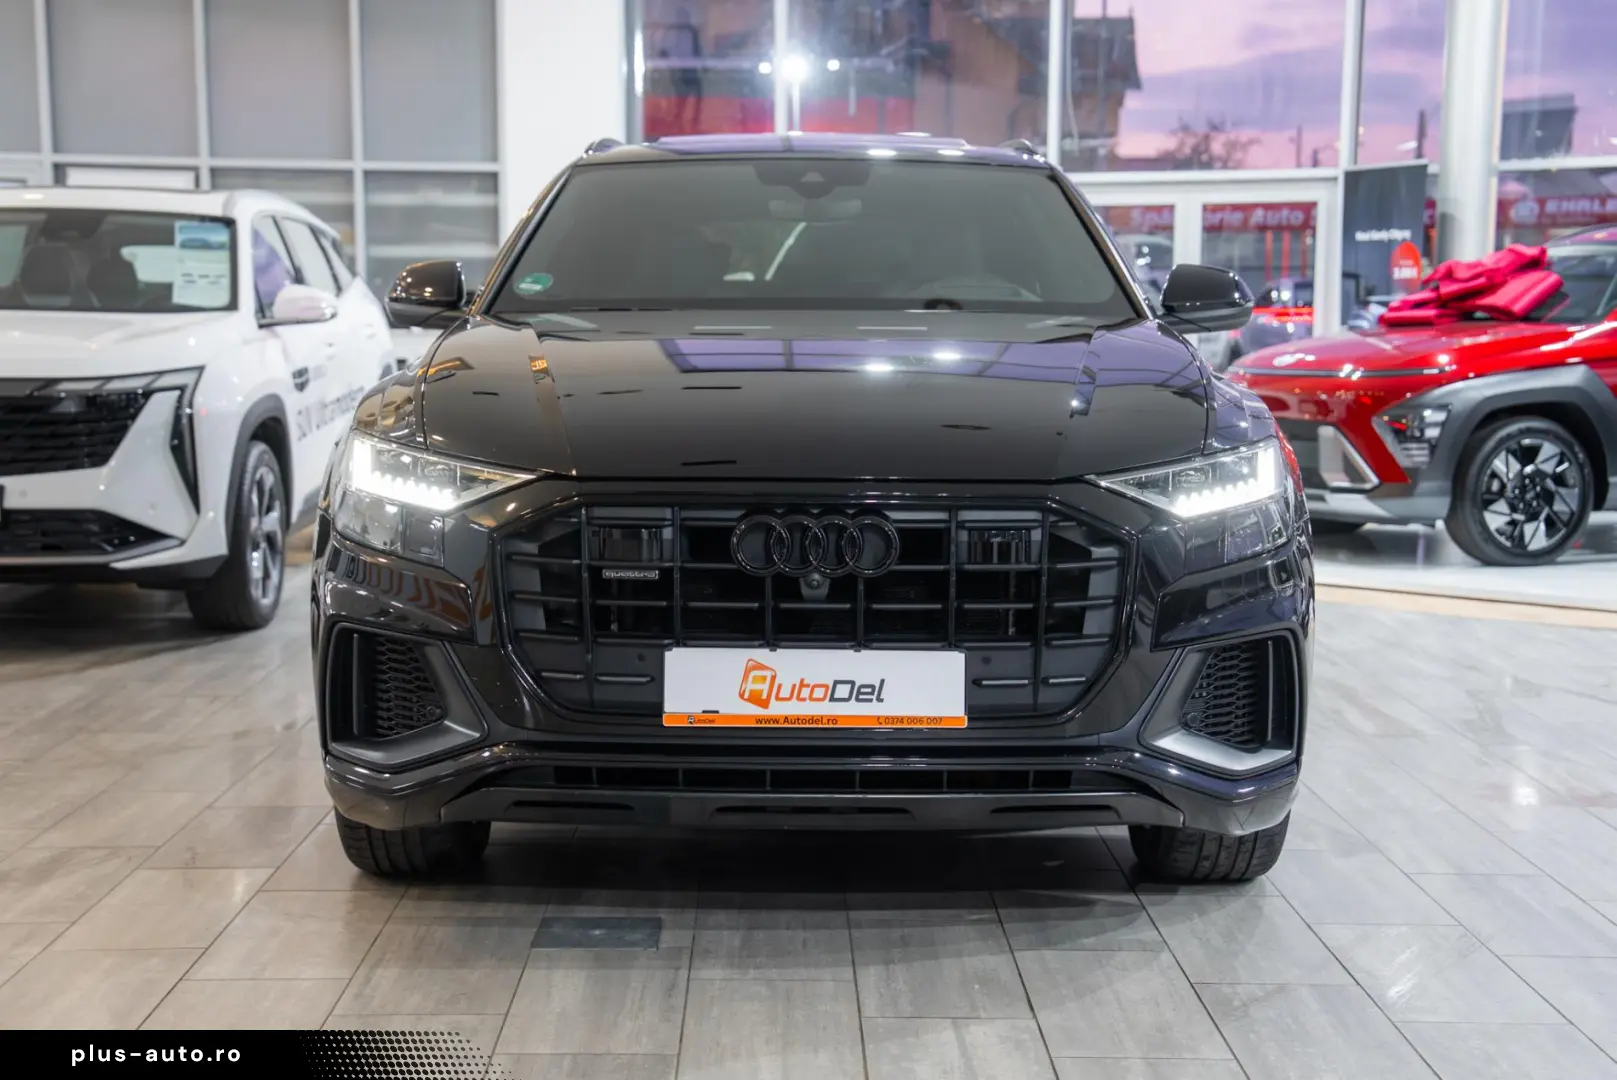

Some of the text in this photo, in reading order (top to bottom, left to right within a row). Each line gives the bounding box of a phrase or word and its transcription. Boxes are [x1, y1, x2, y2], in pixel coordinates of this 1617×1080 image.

[1249, 206, 1305, 227] Auto
[604, 570, 657, 578] quattro
[739, 658, 885, 710] AutoDel
[755, 715, 838, 726] www.Autodel.ro
[884, 716, 905, 726] 0374
[906, 716, 925, 726] 006
